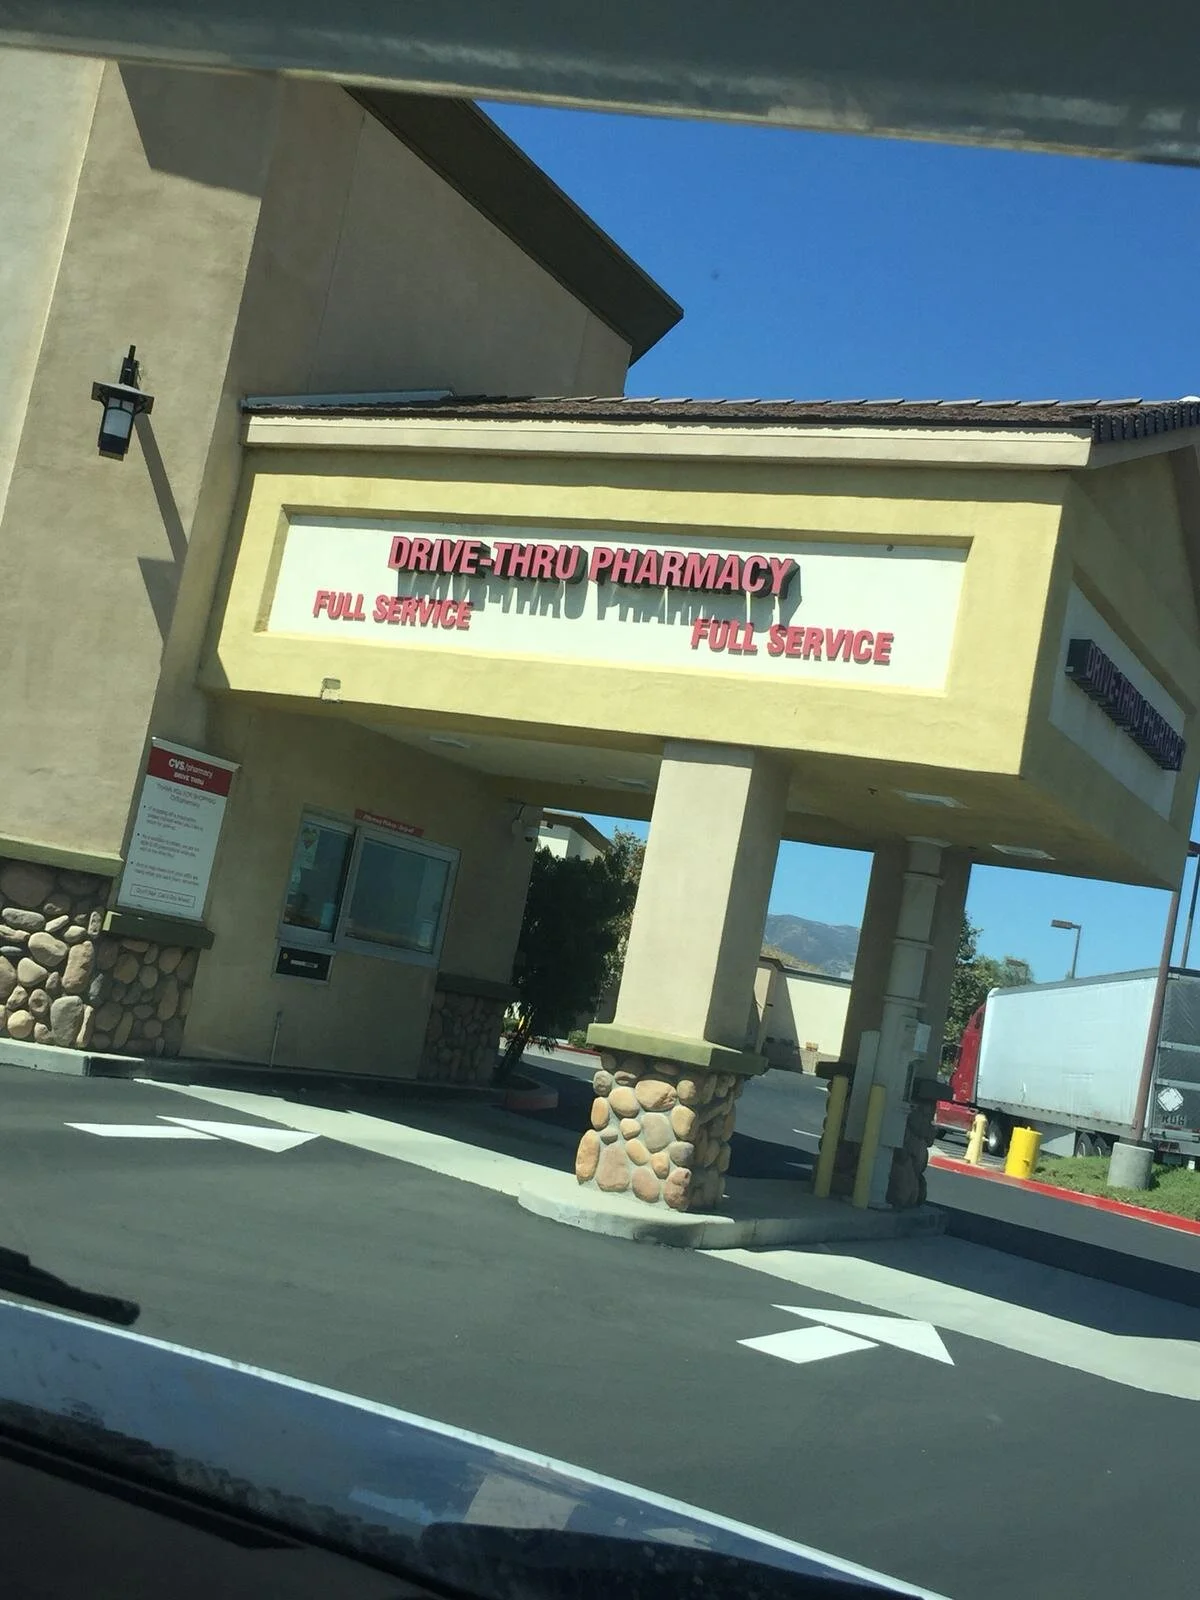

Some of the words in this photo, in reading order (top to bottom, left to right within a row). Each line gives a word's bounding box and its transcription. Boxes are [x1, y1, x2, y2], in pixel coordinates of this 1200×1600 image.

[388, 536, 582, 580] DRIVE-THRU
[588, 546, 796, 596] PHARMACY
[313, 590, 365, 621] FULL
[372, 594, 474, 631] SERVICE
[690, 617, 758, 655] FULL
[767, 624, 894, 666] SERVICE
